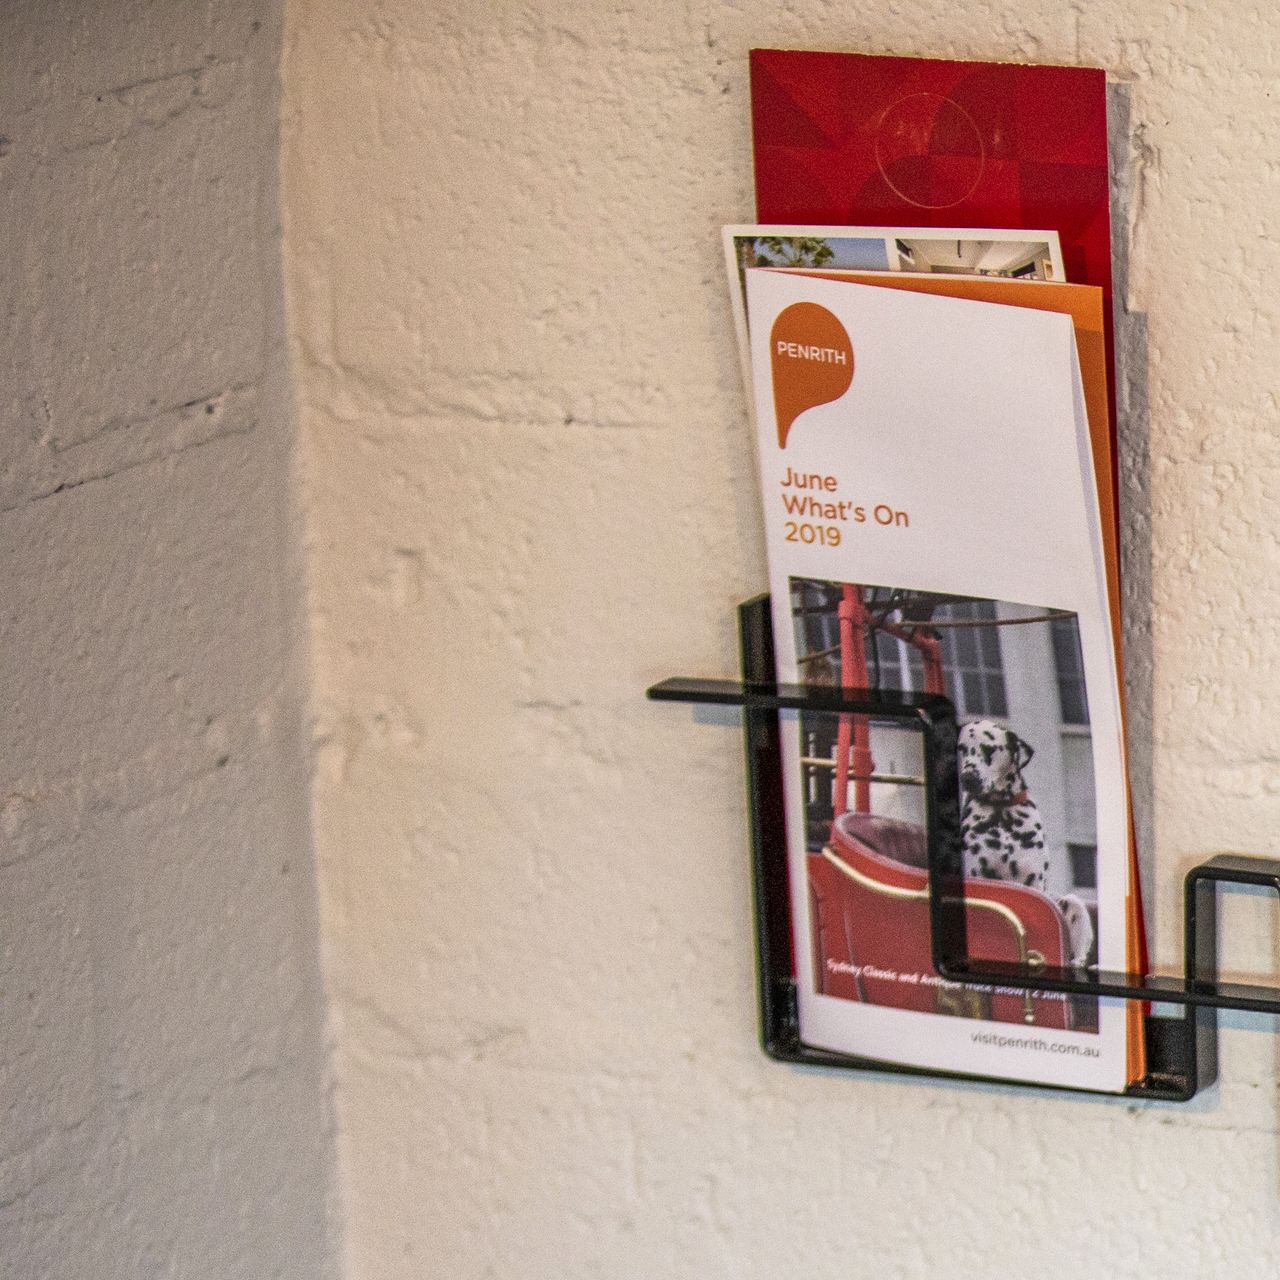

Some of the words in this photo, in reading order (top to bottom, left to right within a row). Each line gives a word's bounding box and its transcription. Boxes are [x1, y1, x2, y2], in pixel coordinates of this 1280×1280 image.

[776, 340, 847, 365] PENRITH
[780, 467, 838, 493] June
[782, 494, 866, 523] What's
[873, 504, 910, 528] On
[784, 521, 841, 547] 2019
[970, 1031, 1100, 1058] visitpenrith.com.au
